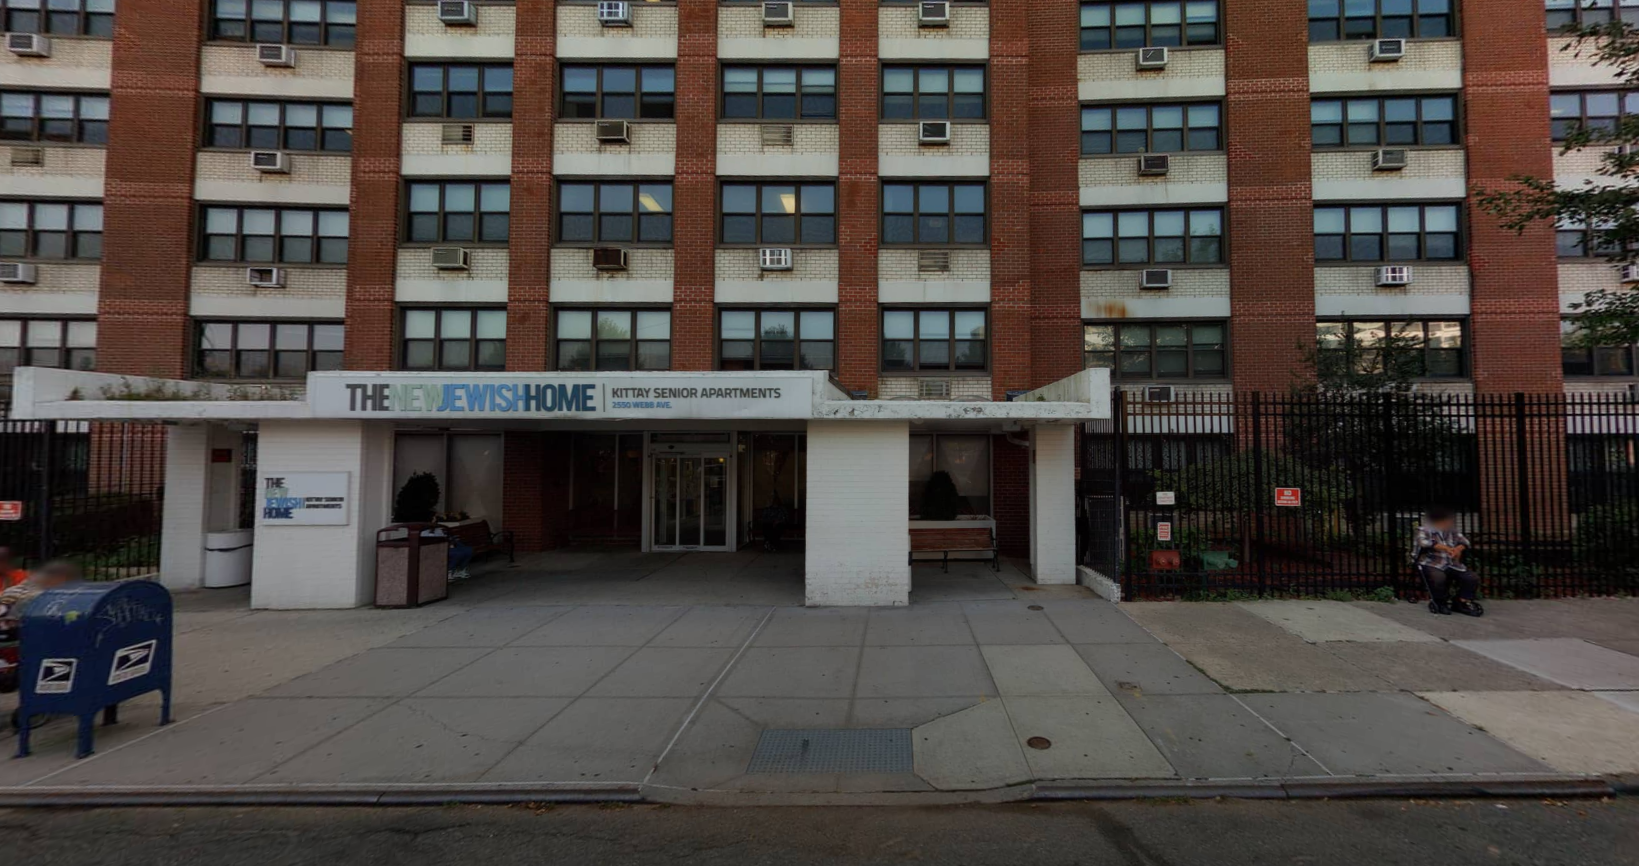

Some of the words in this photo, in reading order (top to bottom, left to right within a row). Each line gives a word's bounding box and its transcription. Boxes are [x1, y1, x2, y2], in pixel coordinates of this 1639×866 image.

[612, 387, 651, 399] KITTAY
[653, 387, 698, 399] SENIOR
[700, 387, 781, 399] APARTMENTS
[612, 401, 631, 409] 2550
[633, 401, 655, 409] WEBB
[656, 401, 673, 409] AVE.
[264, 477, 286, 489] THE
[262, 507, 294, 519] HOME
